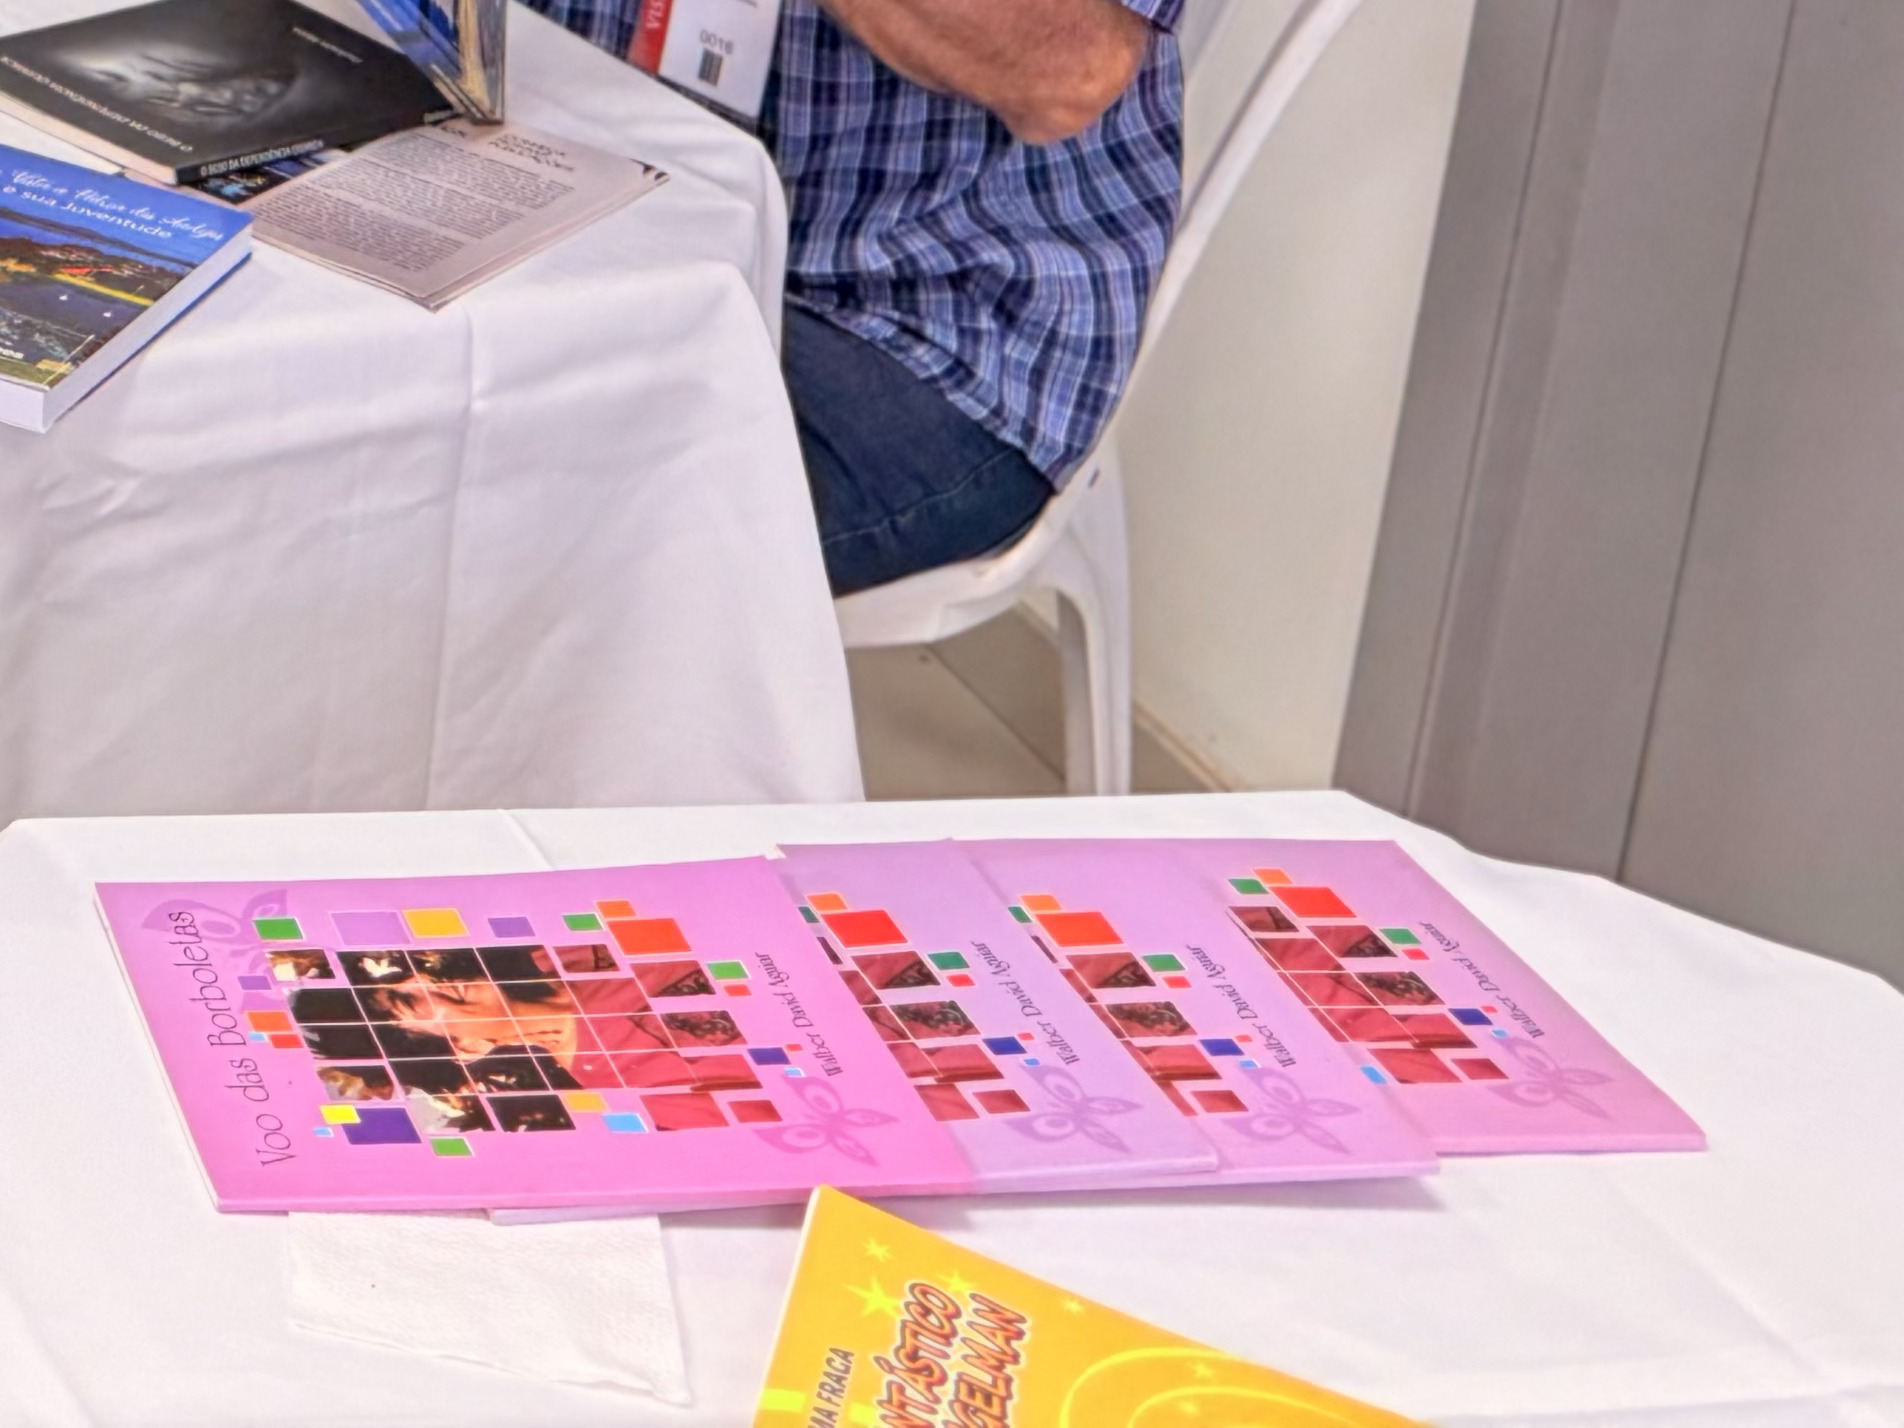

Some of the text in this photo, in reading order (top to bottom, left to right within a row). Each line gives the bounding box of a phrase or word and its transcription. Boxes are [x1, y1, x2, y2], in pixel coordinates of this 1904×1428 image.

[20, 191, 57, 206] sua
[754, 951, 789, 989] Aguiar
[1457, 956, 1498, 992] David
[776, 991, 815, 1029] David
[970, 940, 1080, 1066] Walber David Aguiar
[1218, 983, 1256, 1020] David
[167, 910, 297, 1167] Voo das Borboletas
[816, 1346, 856, 1407] FRAGA
[941, 1292, 1028, 1428] GELMAN
